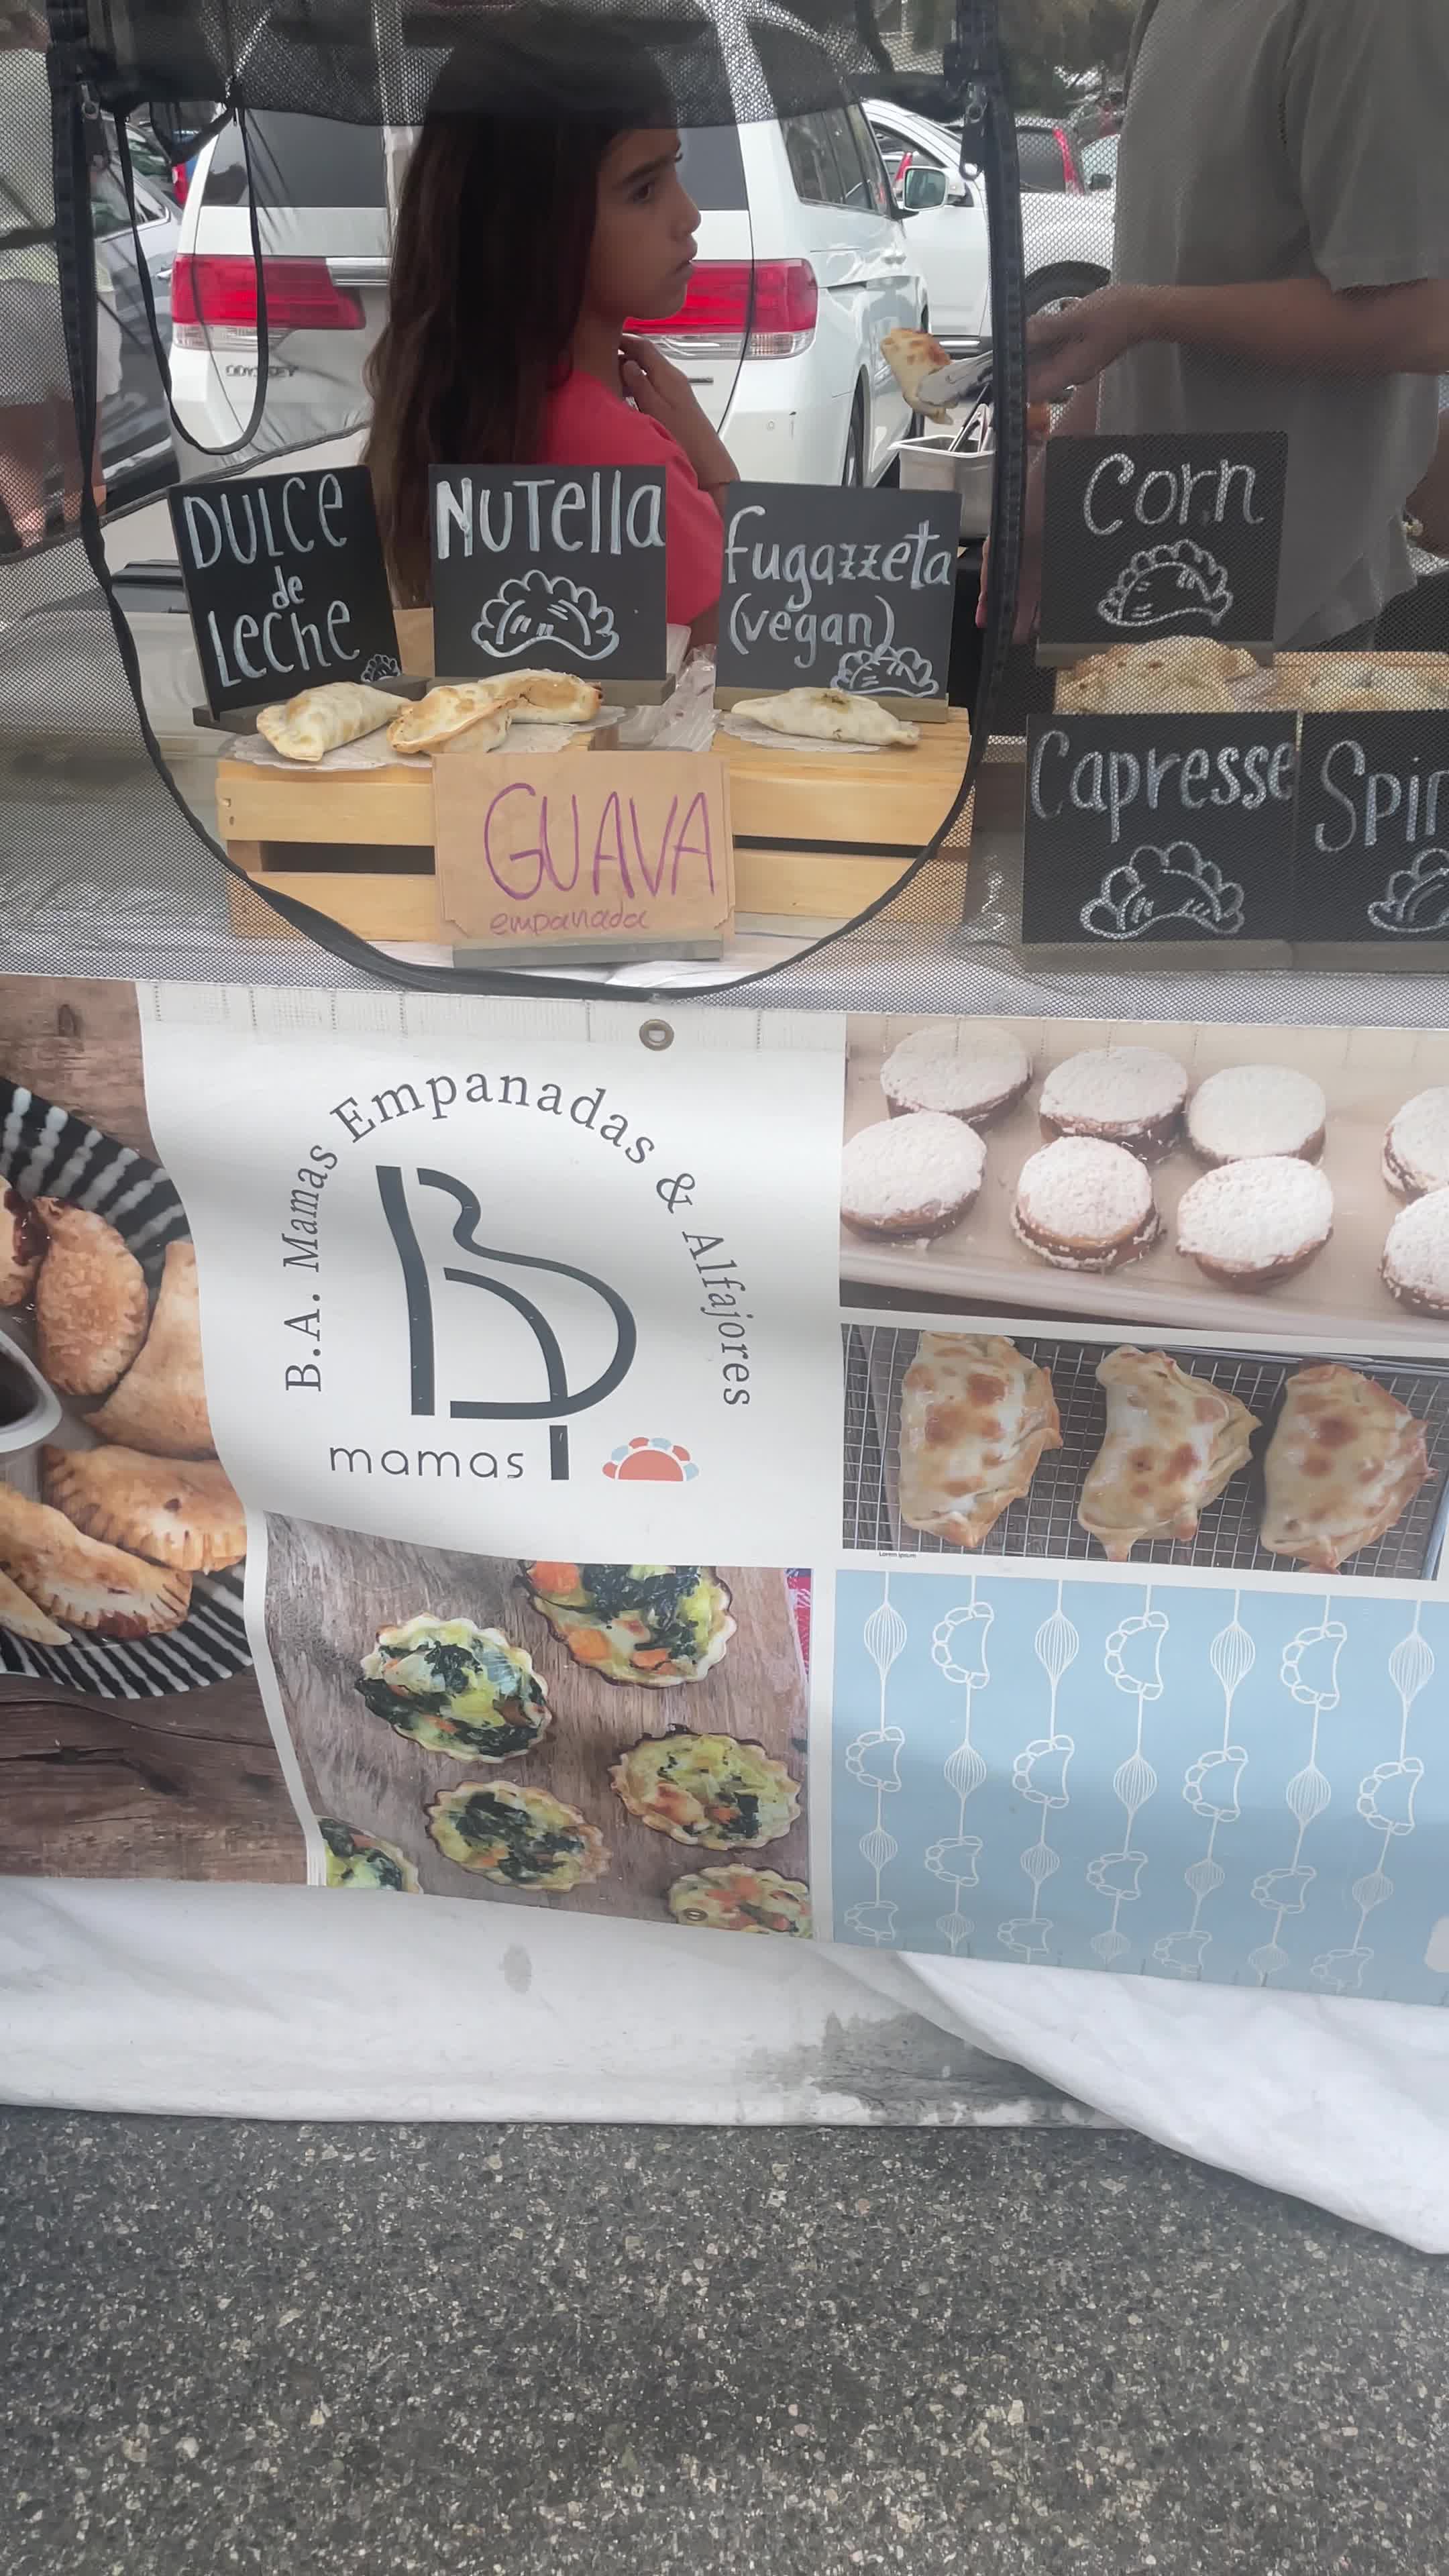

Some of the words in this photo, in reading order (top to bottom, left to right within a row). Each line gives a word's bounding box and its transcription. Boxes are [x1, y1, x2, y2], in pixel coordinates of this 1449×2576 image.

[1083, 453, 1264, 535] Corn
[272, 565, 305, 610] de
[724, 505, 952, 612] fugazzeta
[729, 592, 896, 669] (vegan)
[1030, 730, 1296, 843] Capresse
[484, 782, 715, 900] GUAVA
[489, 900, 651, 935] empanada
[329, 1072, 656, 1164] Empanadas
[282, 1144, 339, 1273] Mamas
[655, 1173, 696, 1214] &
[283, 1293, 322, 1393] B.A.
[682, 1230, 753, 1407] Alfajores
[329, 1446, 525, 1479] mamas
